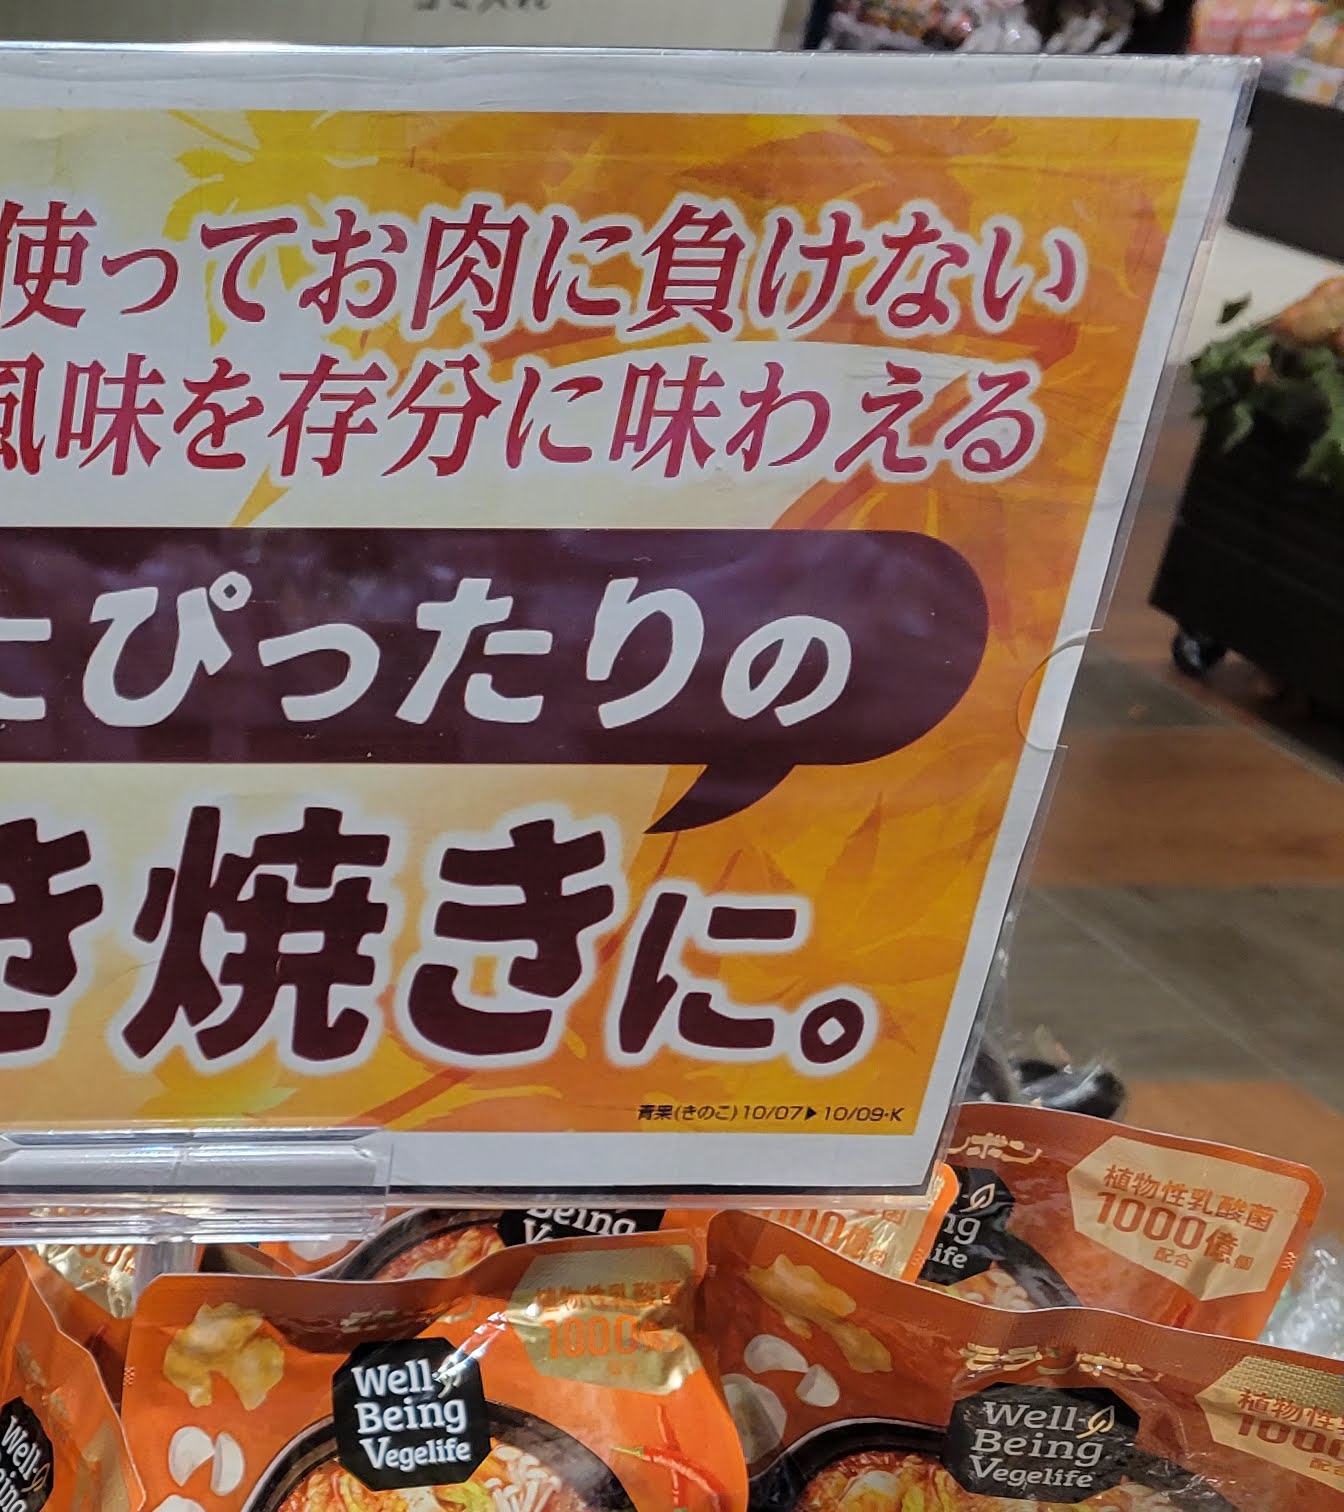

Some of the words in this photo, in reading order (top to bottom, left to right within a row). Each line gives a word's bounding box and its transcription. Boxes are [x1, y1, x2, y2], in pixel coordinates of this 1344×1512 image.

[1103, 1164, 1278, 1233] 植物性乳酸菌
[1153, 1246, 1192, 1270] 配合
[356, 1398, 467, 1434] Being
[983, 1401, 1084, 1435] Well-
[360, 1436, 471, 1471] Vegelife
[971, 1428, 1104, 1466] Being
[970, 1454, 1094, 1489] Vegelife
